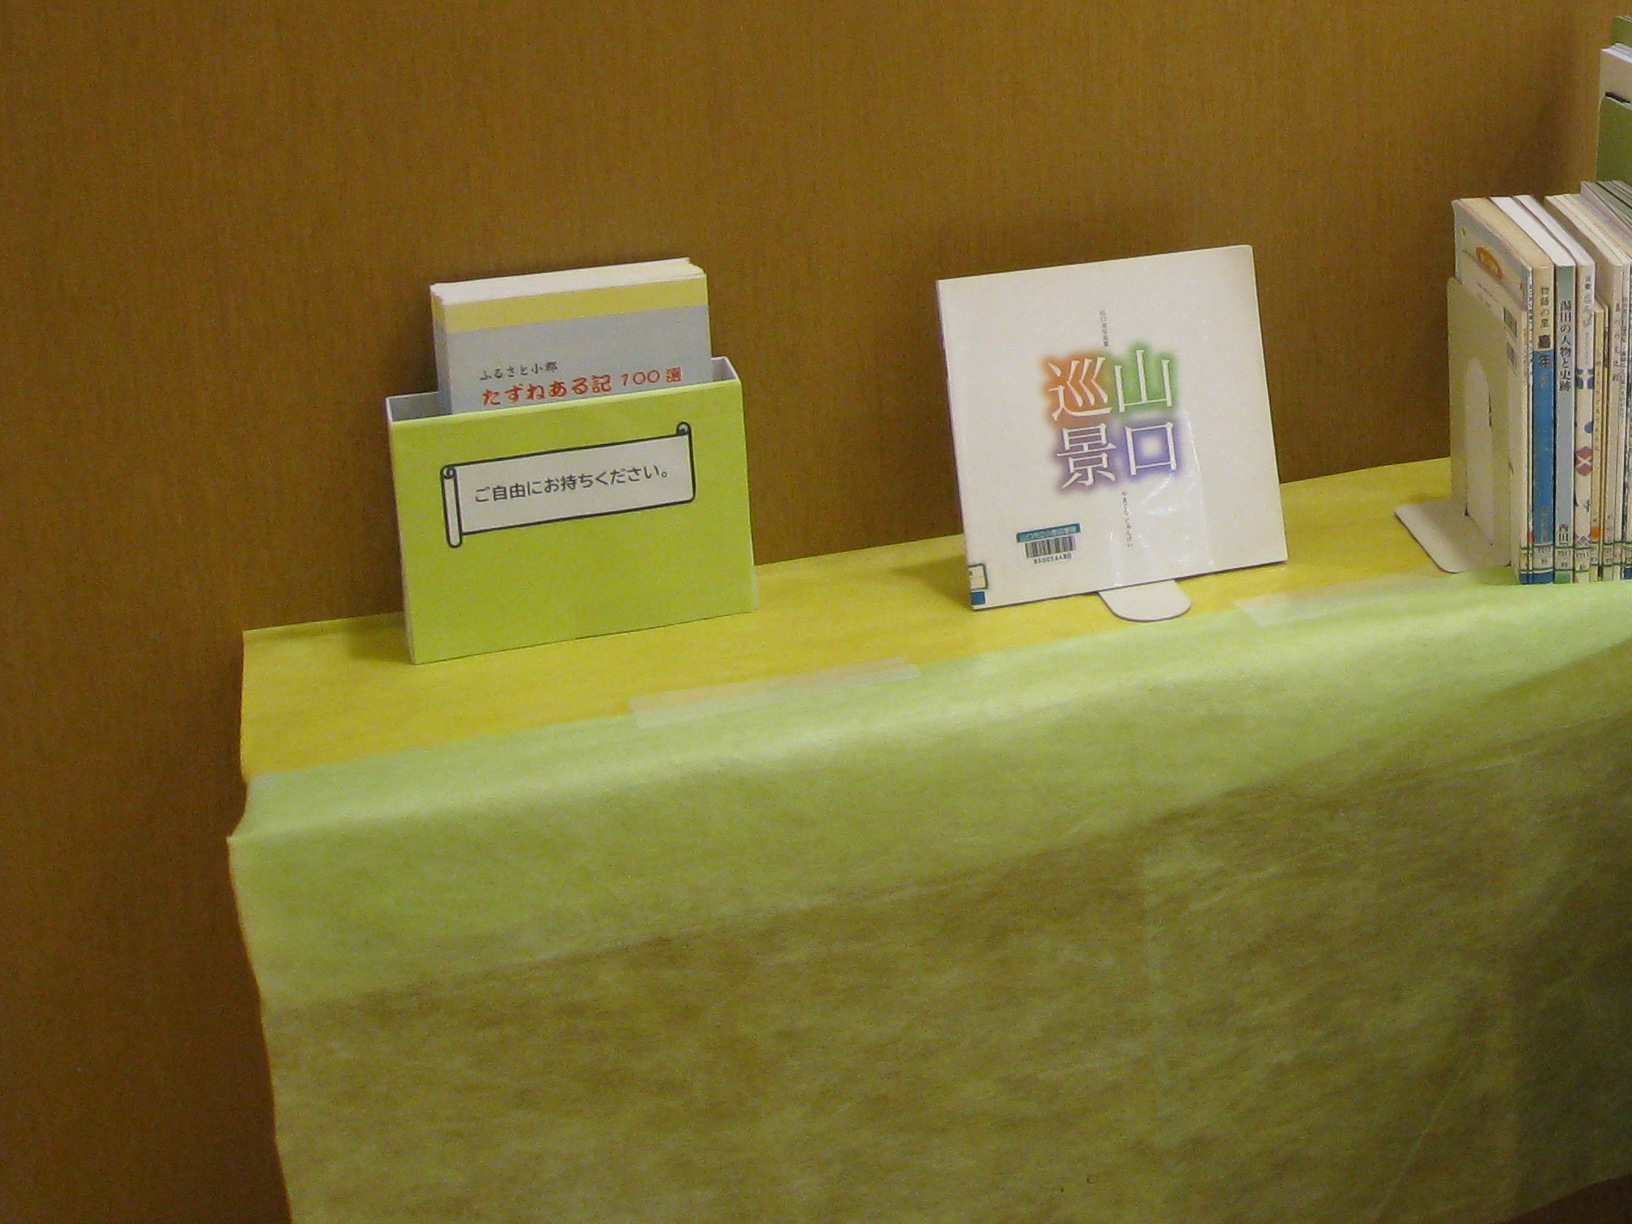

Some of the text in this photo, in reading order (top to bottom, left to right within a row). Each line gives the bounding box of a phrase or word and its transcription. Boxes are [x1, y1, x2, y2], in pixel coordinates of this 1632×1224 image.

[1559, 300, 1572, 392] 湯田の人物と史跡
[474, 465, 668, 503] ご自由にお持ちください。
